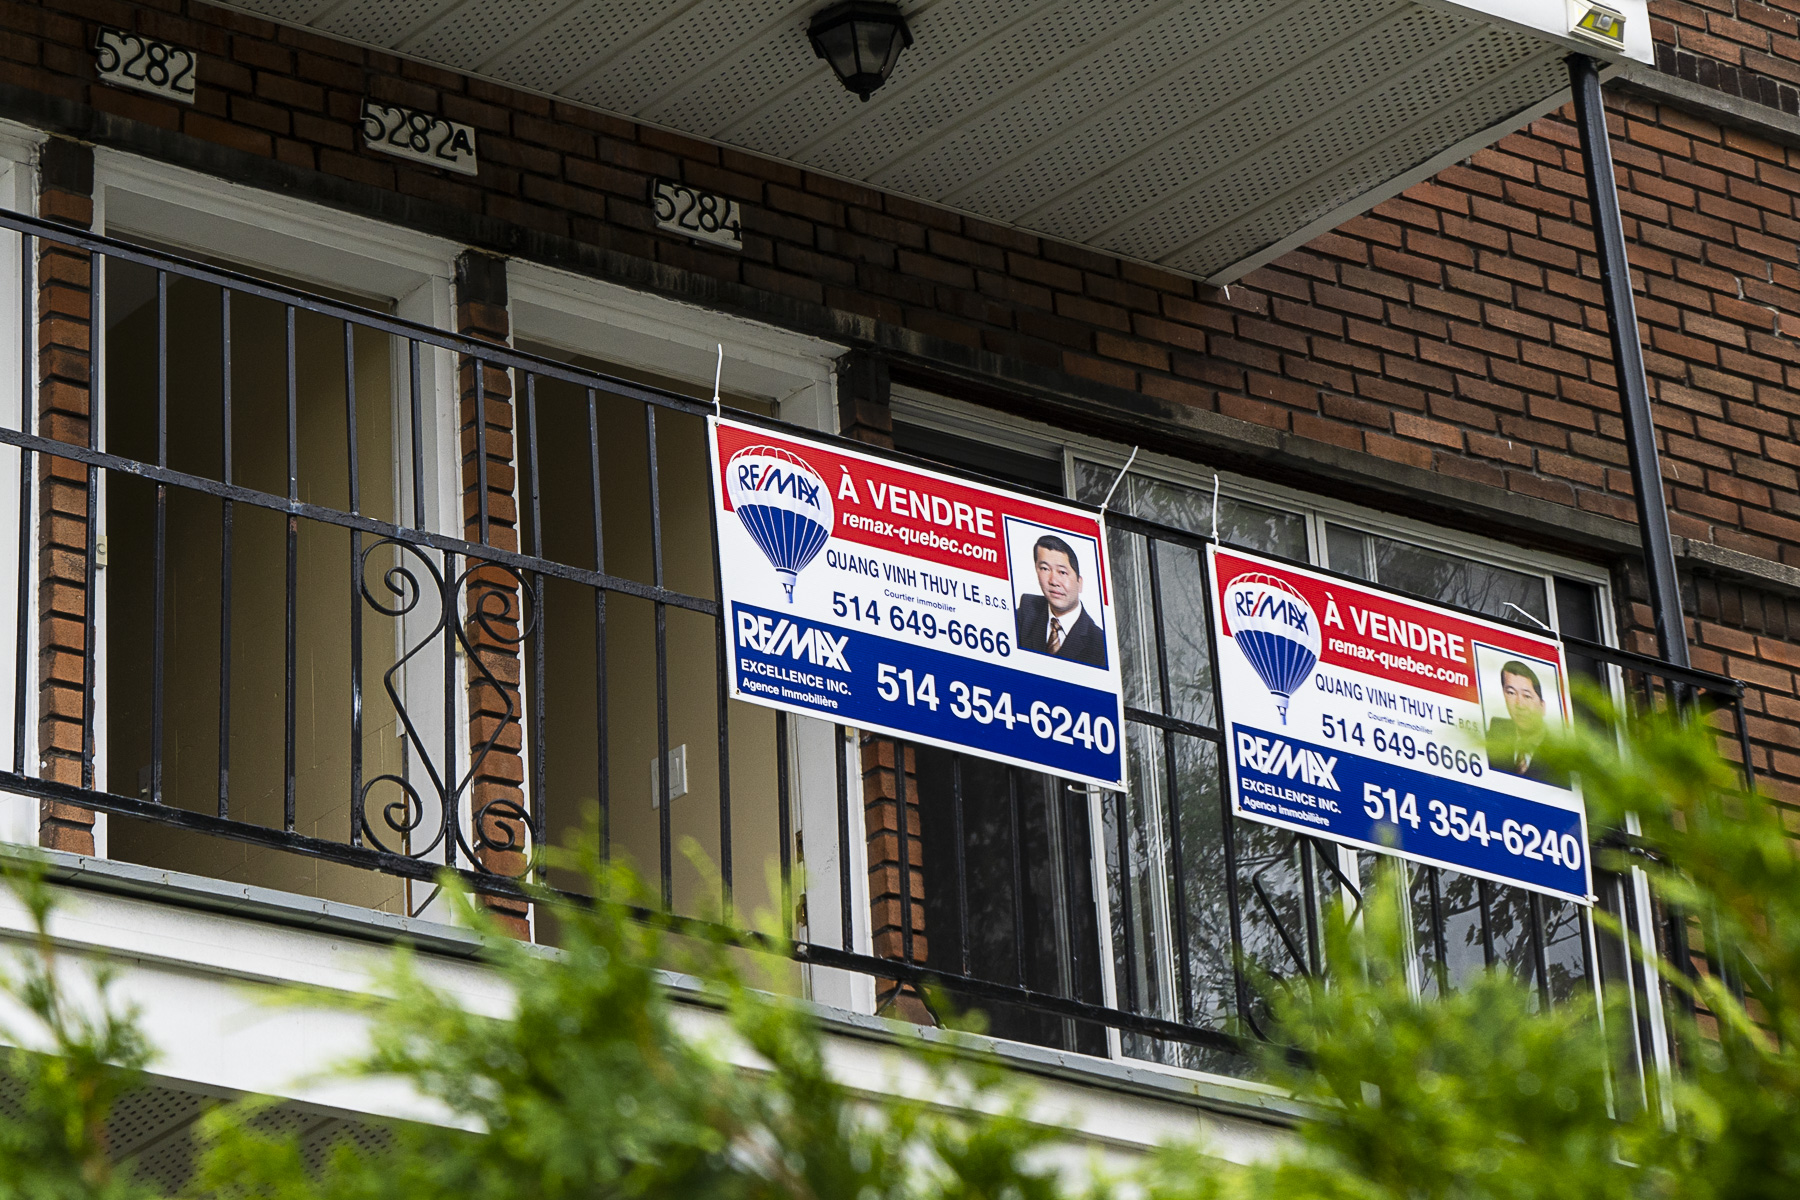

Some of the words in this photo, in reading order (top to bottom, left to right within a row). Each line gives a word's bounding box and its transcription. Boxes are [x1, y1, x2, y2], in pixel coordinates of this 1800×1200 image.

[96, 27, 195, 95] 5282
[362, 103, 474, 163] 5282A
[654, 180, 742, 240] 5284
[738, 464, 820, 510] RE/MAX
[837, 464, 860, 504] À
[866, 479, 997, 539] VENDRE
[842, 512, 998, 563] remax-quebec.com
[826, 549, 879, 578] QUANG
[883, 562, 917, 588] VINH
[920, 572, 958, 598] THUY
[985, 595, 1010, 611] B.C.S.
[884, 588, 915, 603] Courtier
[916, 597, 956, 613] immobilier
[737, 610, 852, 673] RE/MAX
[832, 591, 881, 626] 514
[889, 605, 1011, 657] 649-6666
[1235, 591, 1309, 635] RE/MAX
[1323, 591, 1344, 630] À
[1348, 605, 1467, 664] VENDRE
[740, 658, 824, 689] EXCELLENCE
[826, 678, 852, 696] INC.
[1328, 637, 1469, 688] remax-quebec.com
[742, 677, 780, 695] Agence
[781, 686, 839, 709] immobilière
[877, 662, 940, 712] 514
[949, 681, 1116, 755] 354-6240
[1315, 673, 1363, 701] QUANG
[1365, 686, 1397, 711] VINH
[1399, 695, 1434, 720] THUY
[1367, 711, 1395, 725] Courtier
[1237, 731, 1341, 792] RE/MAX
[1322, 713, 1365, 747] 514
[1373, 728, 1483, 777] 649-6666
[1241, 777, 1317, 807] EXCELLENCE
[1317, 797, 1342, 814] INC.
[1243, 795, 1277, 813] Agence
[1278, 804, 1330, 827] immobilière
[1363, 782, 1421, 830] 514
[1428, 799, 1582, 871] 354-6240
